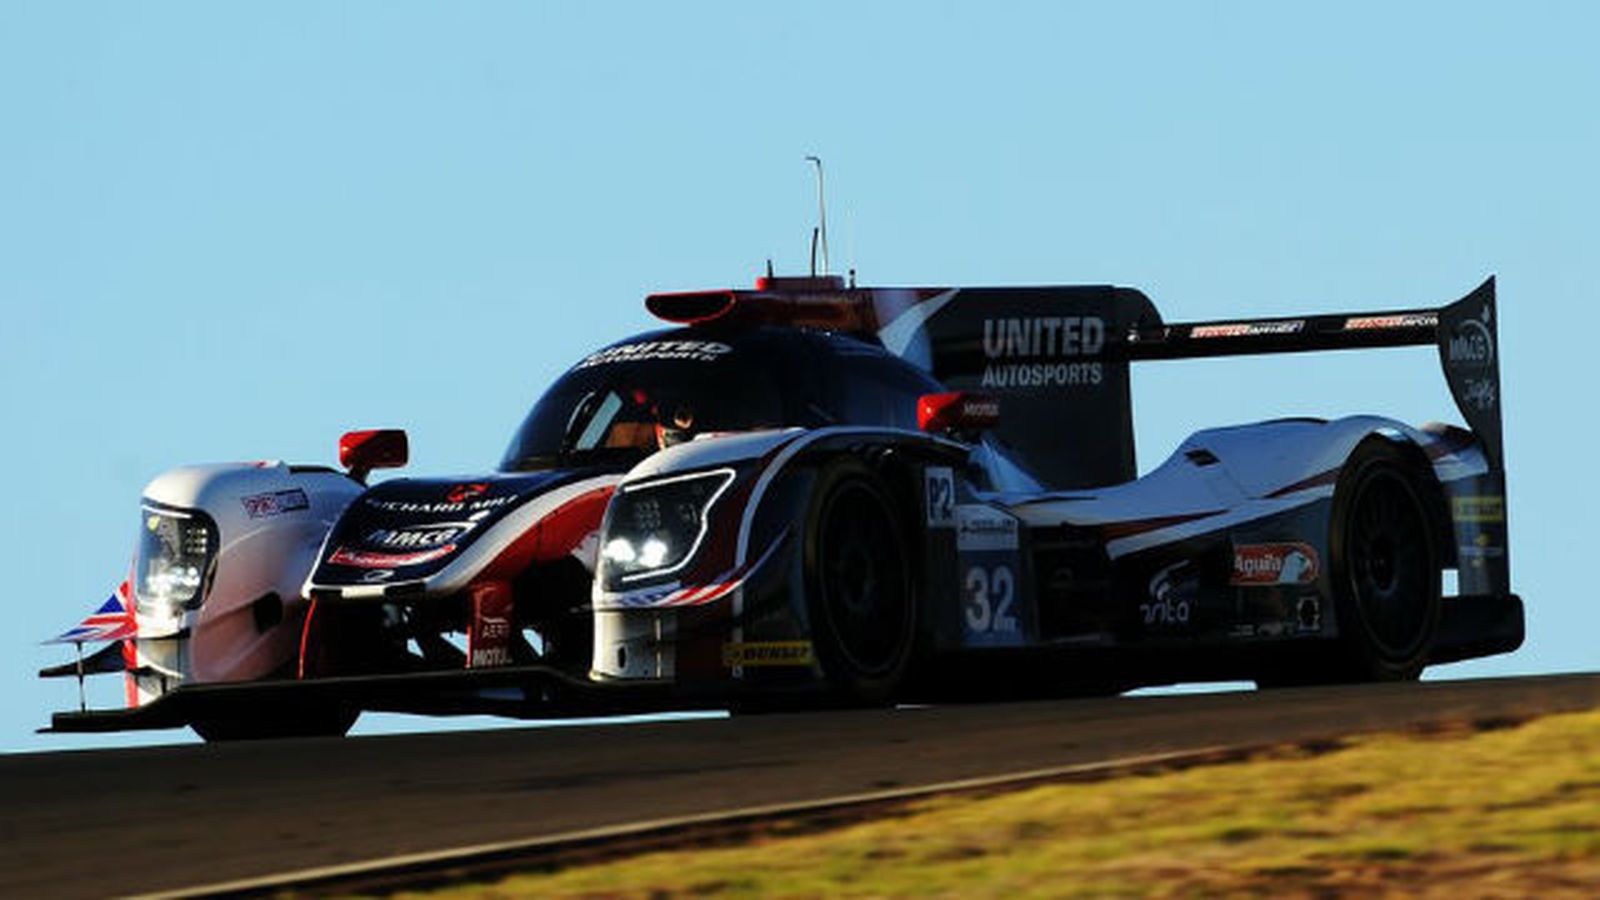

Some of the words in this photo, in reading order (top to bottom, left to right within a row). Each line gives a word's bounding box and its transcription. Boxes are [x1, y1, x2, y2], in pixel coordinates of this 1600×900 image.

[983, 316, 1105, 358] UNITED
[981, 361, 1102, 387] AUTOSPORTS
[929, 476, 951, 520] P2
[965, 566, 1017, 632] 32
